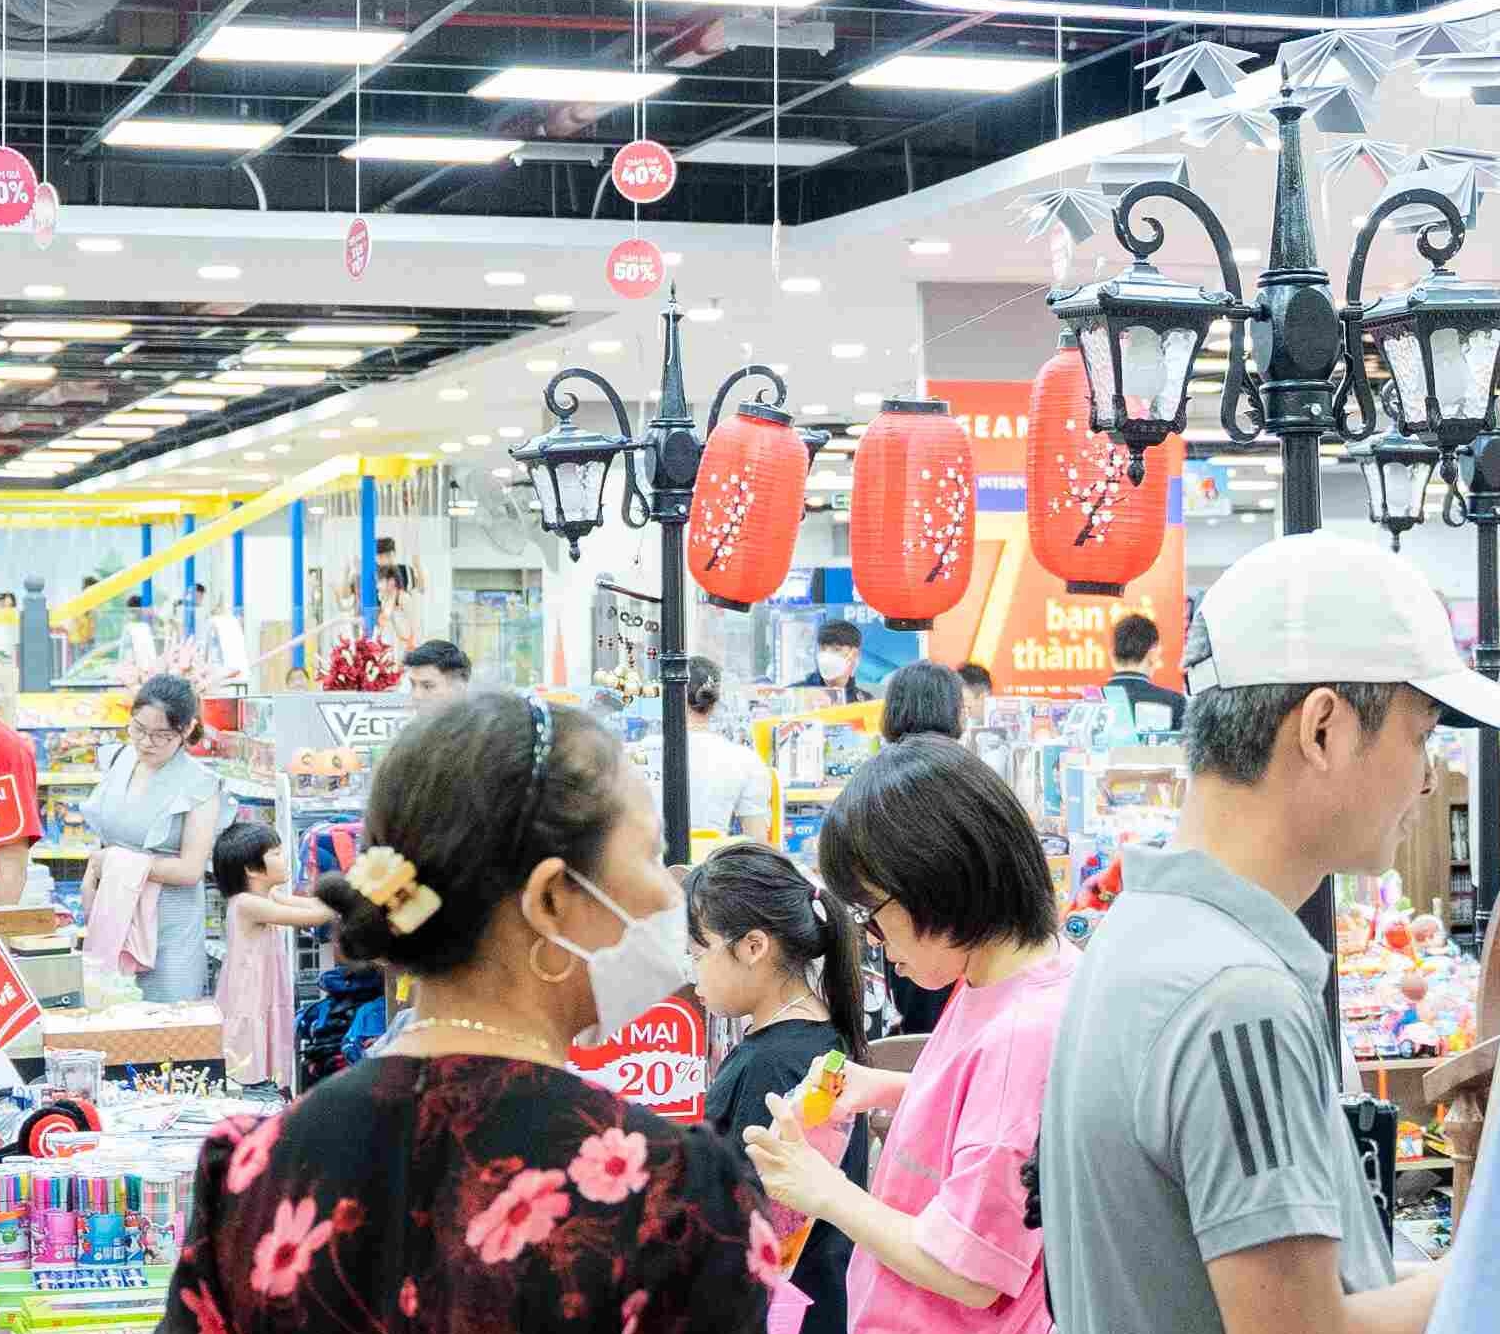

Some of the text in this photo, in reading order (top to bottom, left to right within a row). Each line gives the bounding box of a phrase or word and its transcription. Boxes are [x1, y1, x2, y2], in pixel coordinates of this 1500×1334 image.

[620, 165, 667, 185] 40%
[1045, 598, 1104, 639] bạn
[1011, 638, 1107, 671] thành
[332, 711, 400, 737] VECT
[630, 1021, 678, 1050] MẠI
[617, 1060, 701, 1096] 20%
